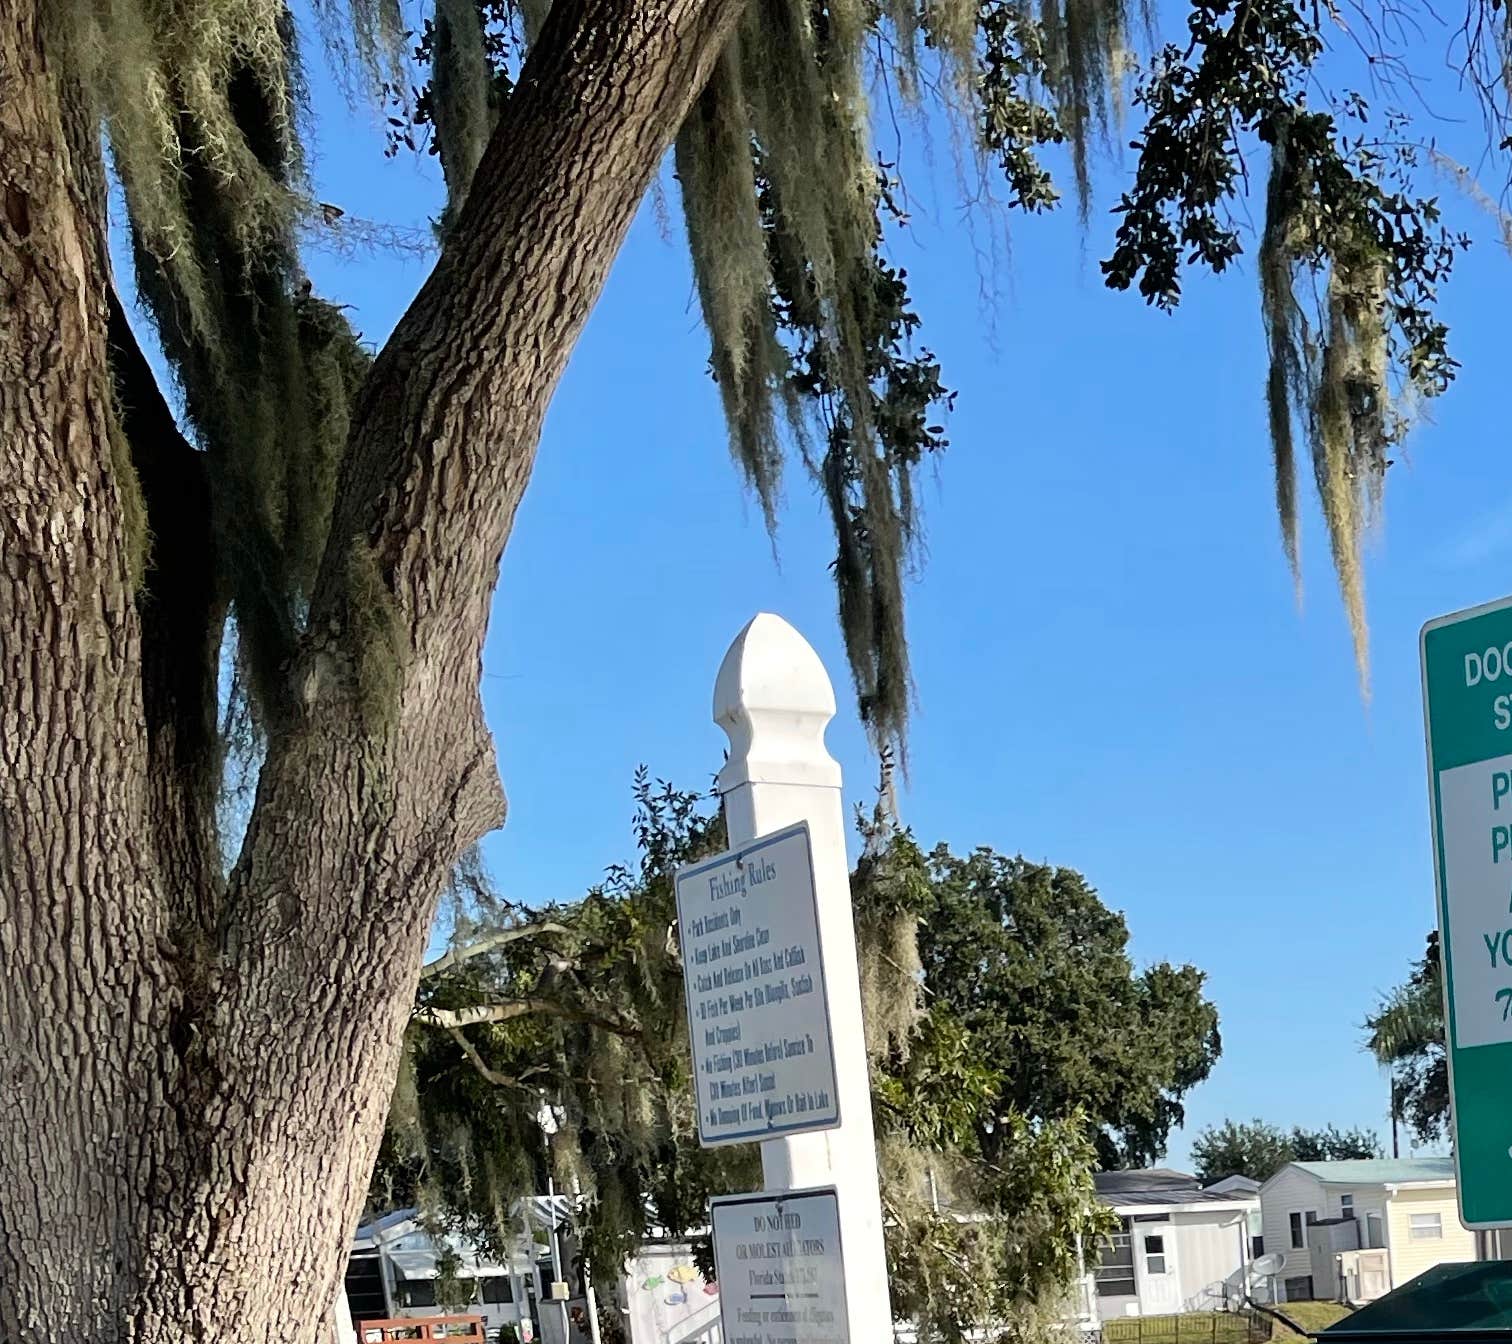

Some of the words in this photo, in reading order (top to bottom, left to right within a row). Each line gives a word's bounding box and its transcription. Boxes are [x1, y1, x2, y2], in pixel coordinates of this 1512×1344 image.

[709, 868, 747, 902] Fishing
[747, 860, 777, 887] Rules
[754, 1216, 766, 1232] DO
[767, 1215, 783, 1231] NOT
